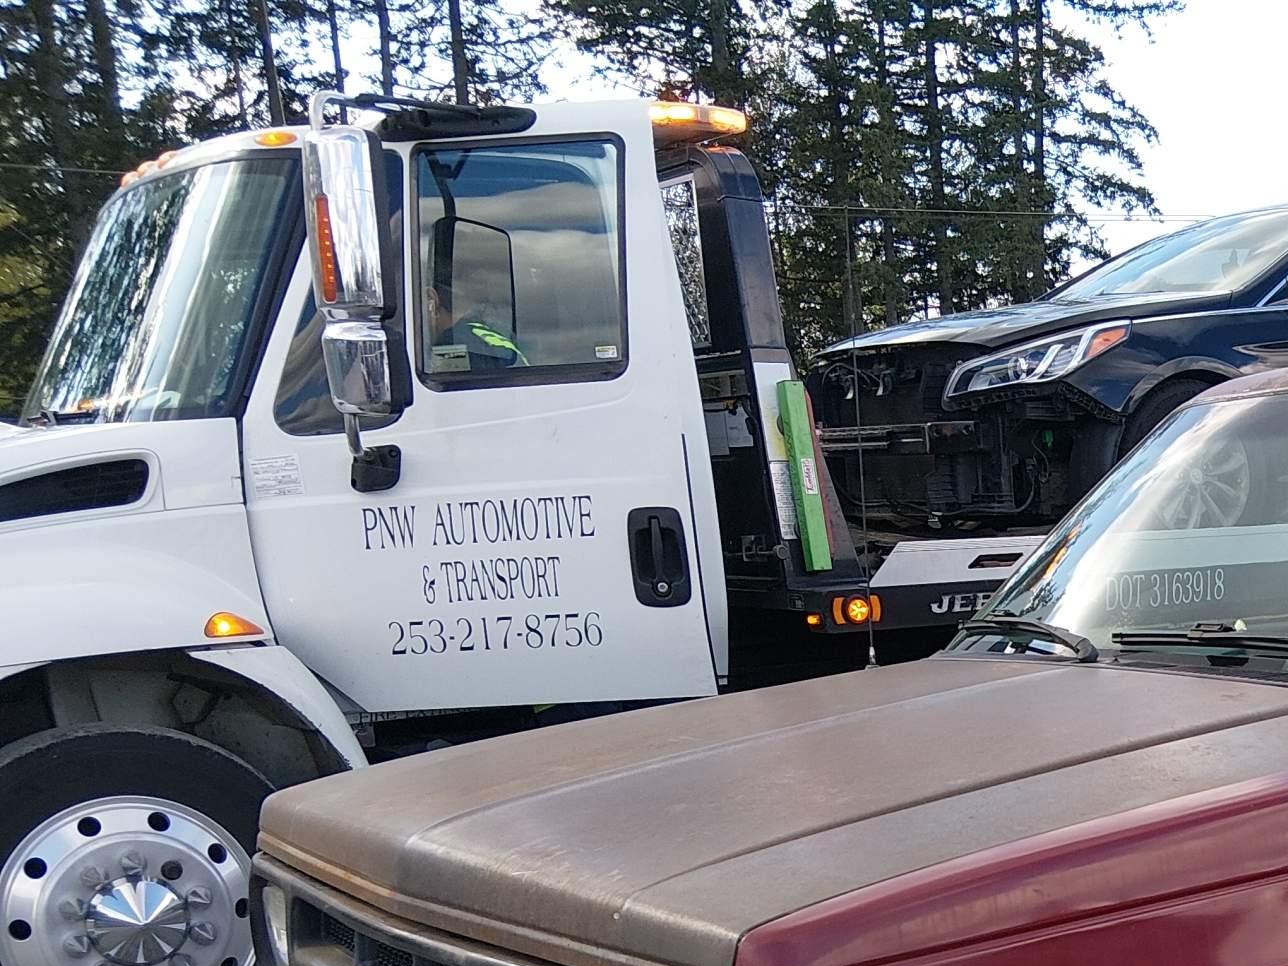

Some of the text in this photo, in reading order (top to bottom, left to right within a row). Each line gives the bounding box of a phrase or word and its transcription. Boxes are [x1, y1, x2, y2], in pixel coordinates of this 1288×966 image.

[361, 495, 596, 550] PNW AUTOMOTIVE
[422, 556, 561, 604] & TRANSPORT
[1105, 568, 1225, 611] DOT 3163918
[388, 611, 603, 656] 253-217-8756
